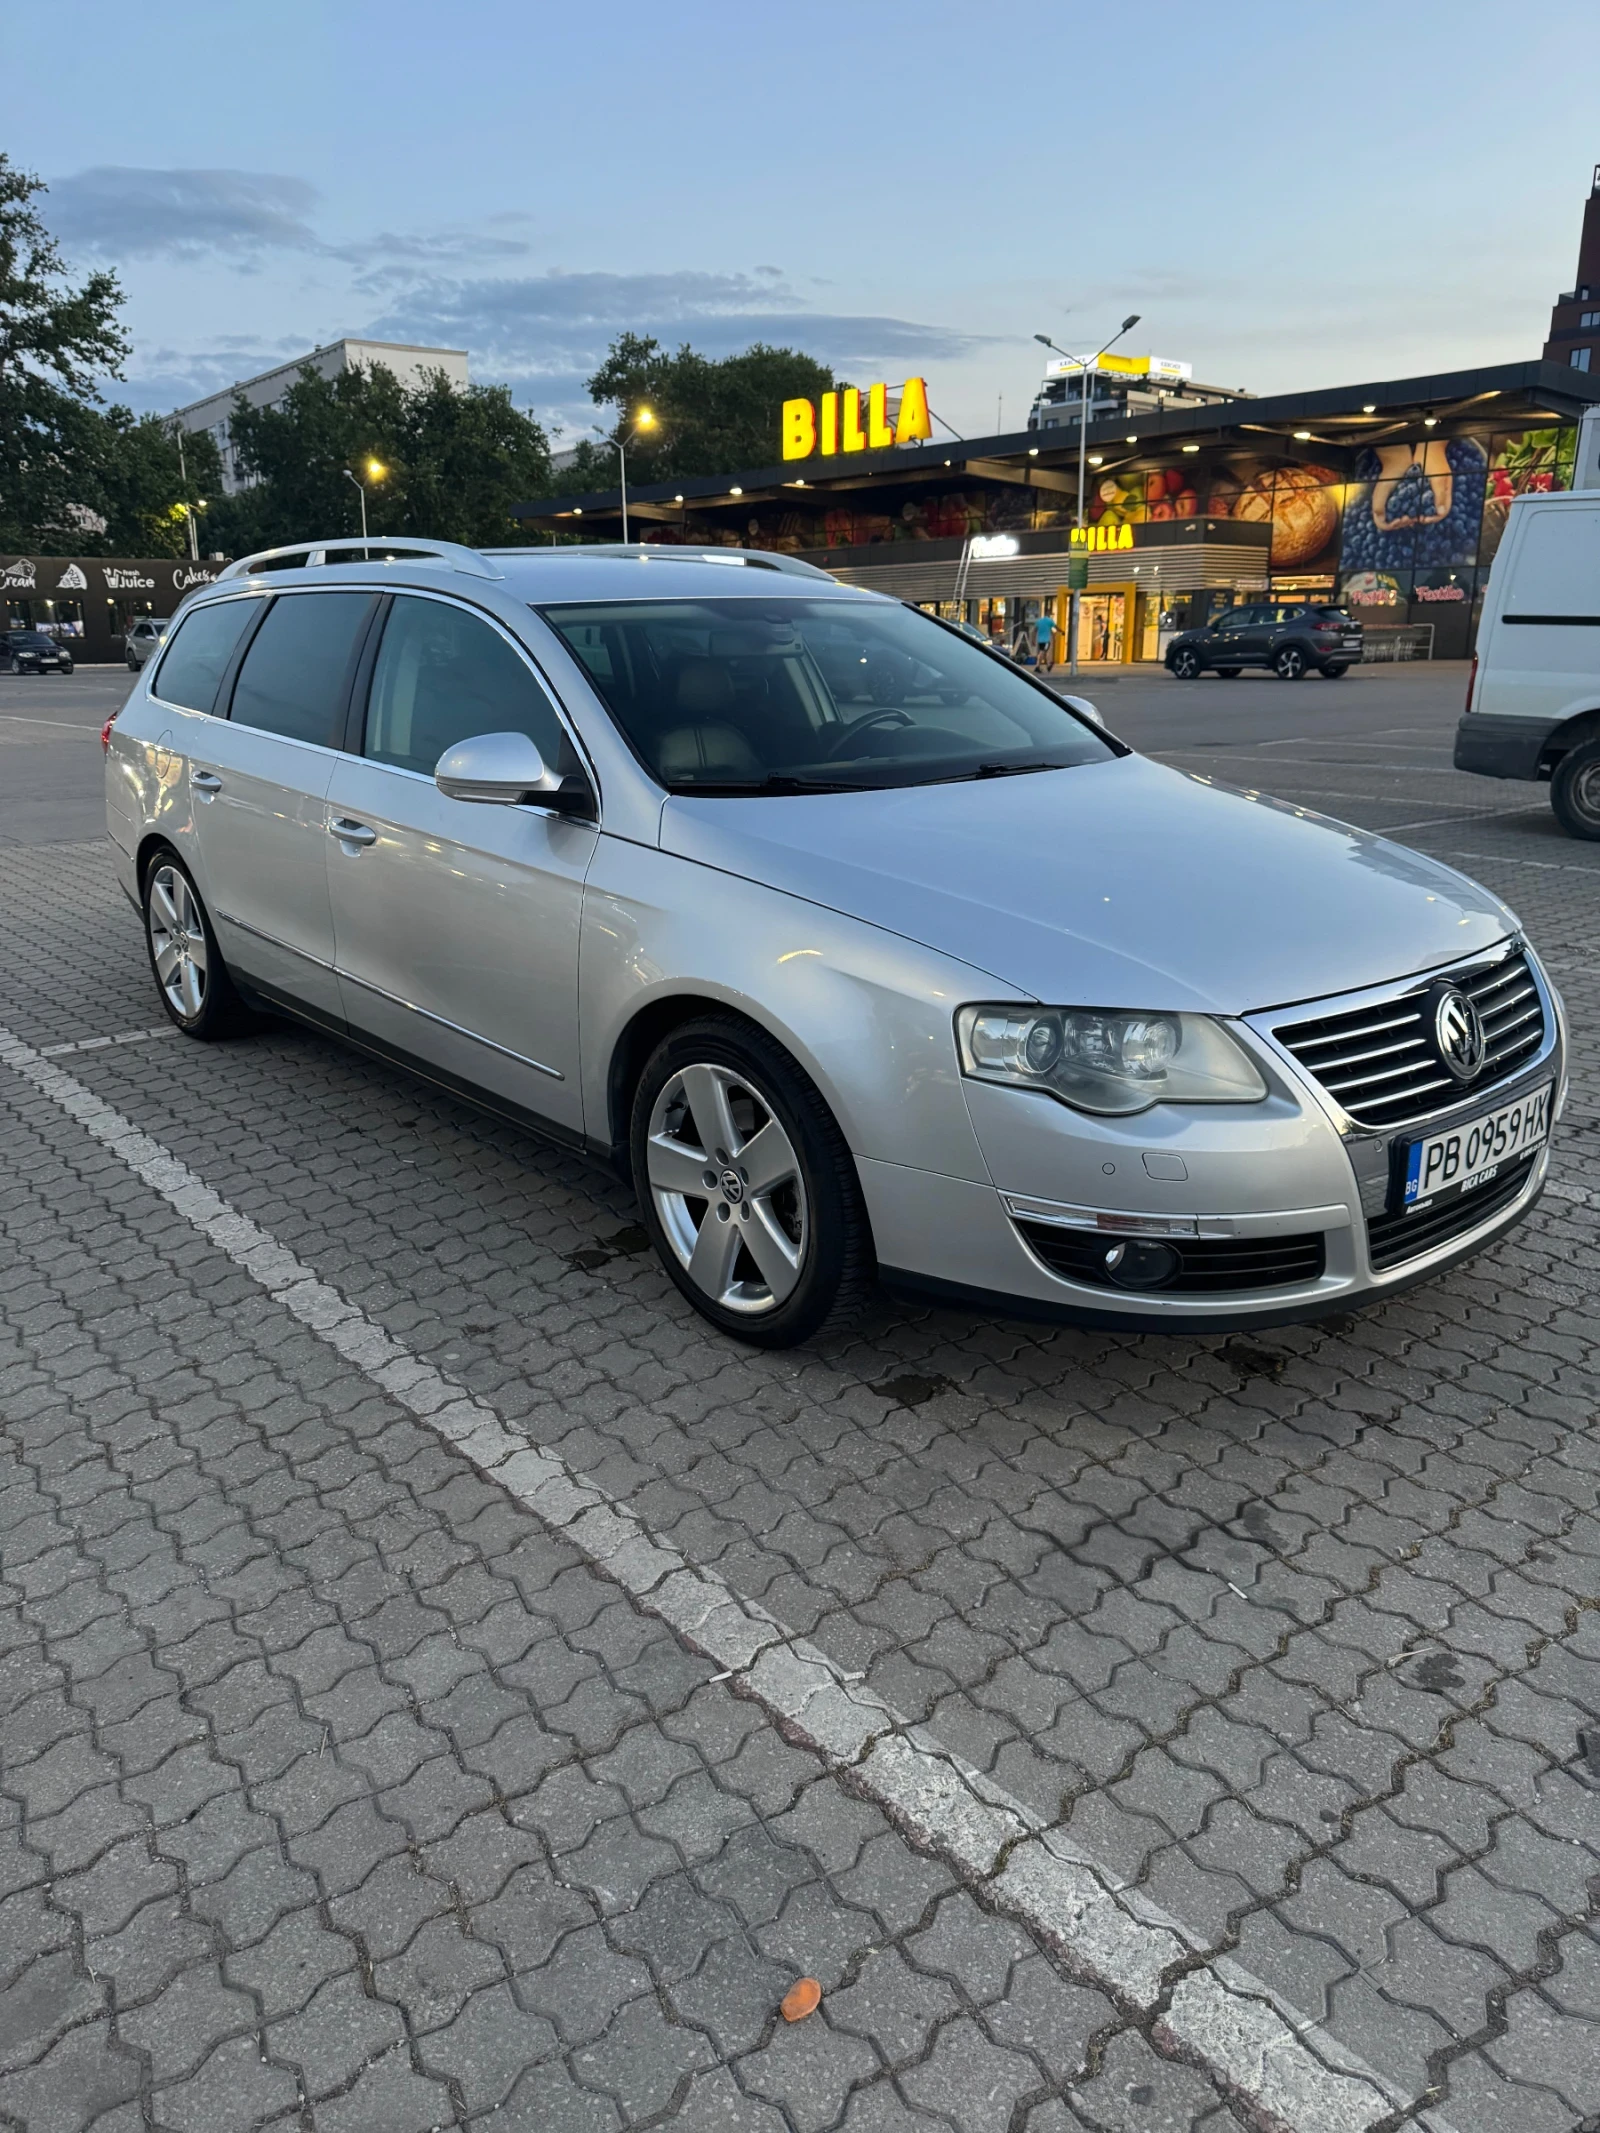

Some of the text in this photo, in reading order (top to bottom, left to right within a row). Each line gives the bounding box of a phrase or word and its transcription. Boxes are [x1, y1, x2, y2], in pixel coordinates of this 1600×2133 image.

[782, 377, 933, 461] BILLA
[119, 576, 155, 589] Juice
[172, 566, 210, 590] Cakes
[1424, 1135, 1461, 1189] PB
[1465, 1107, 1521, 1170] 0959
[1521, 1091, 1549, 1144] HX
[1405, 1178, 1418, 1195] BG
